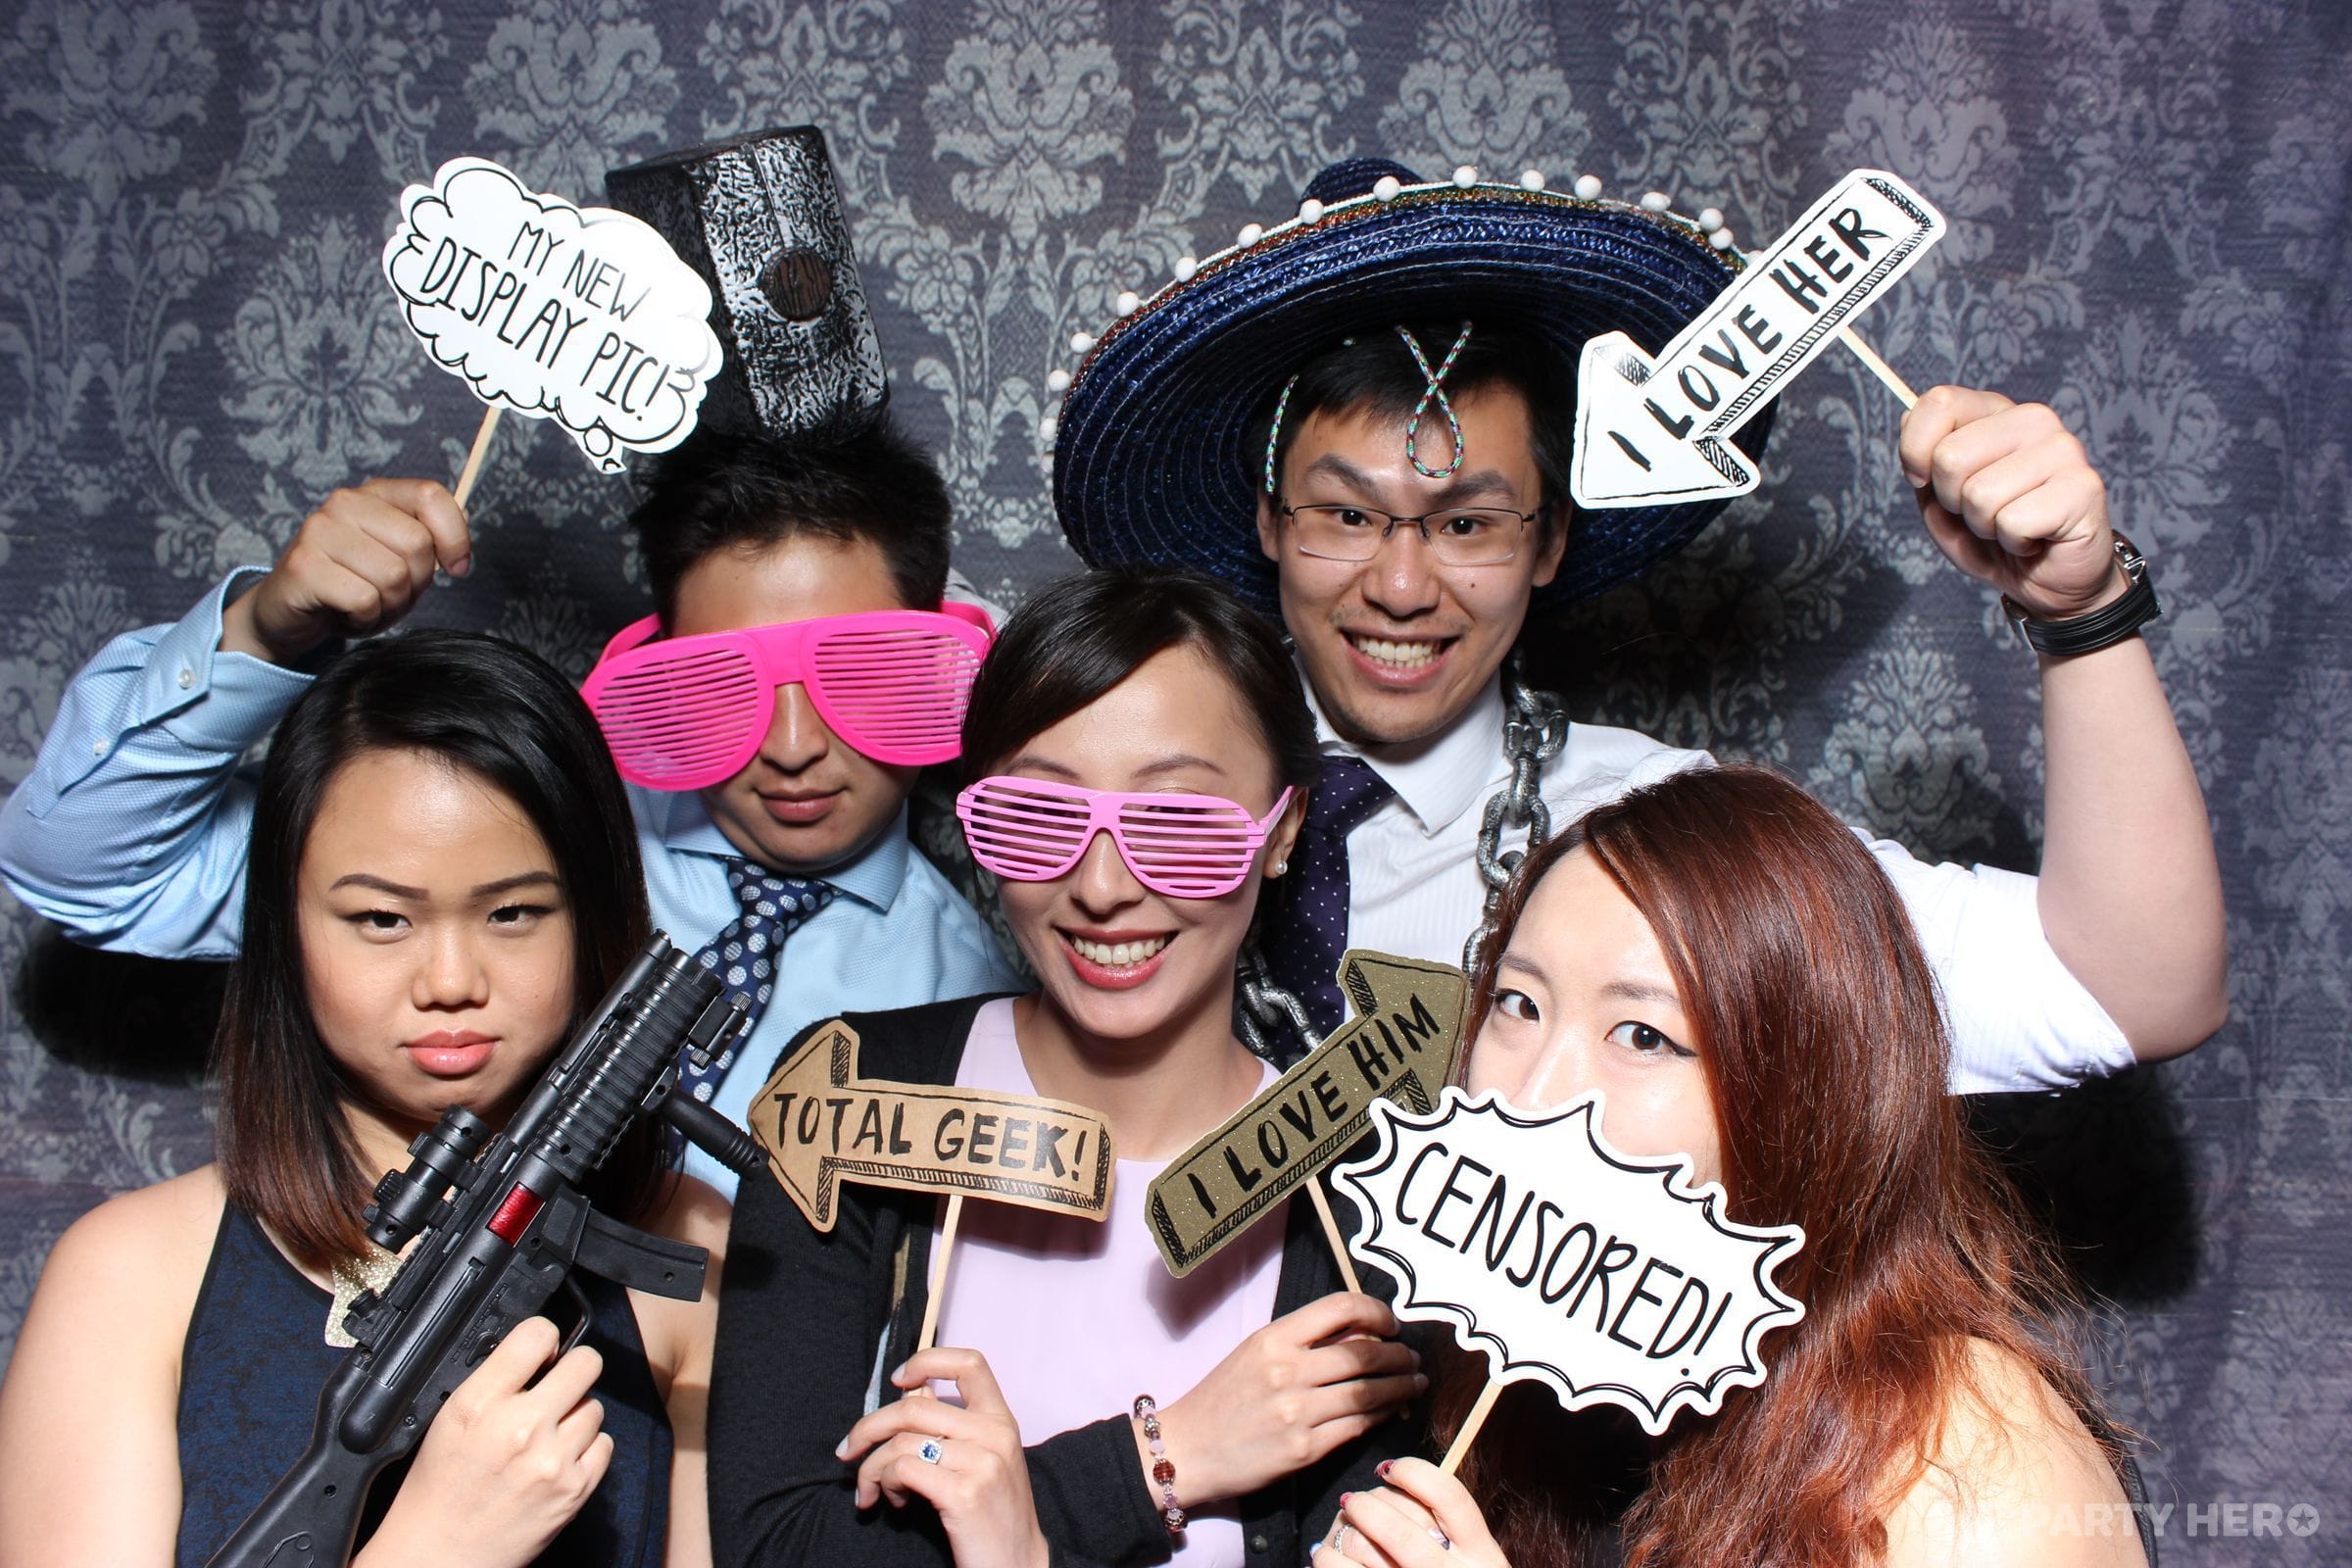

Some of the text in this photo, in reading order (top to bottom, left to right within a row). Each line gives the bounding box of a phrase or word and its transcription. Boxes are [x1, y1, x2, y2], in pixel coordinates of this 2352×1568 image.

[419, 236, 670, 422] DISPLAY PIC!
[508, 220, 654, 322] MY NEW
[1607, 207, 1894, 473] I LOVE HER
[774, 1092, 1088, 1182] TOTAL GEEK!
[1187, 993, 1441, 1218] I LOVE HIM
[1396, 1142, 1733, 1376] CENSORED!
